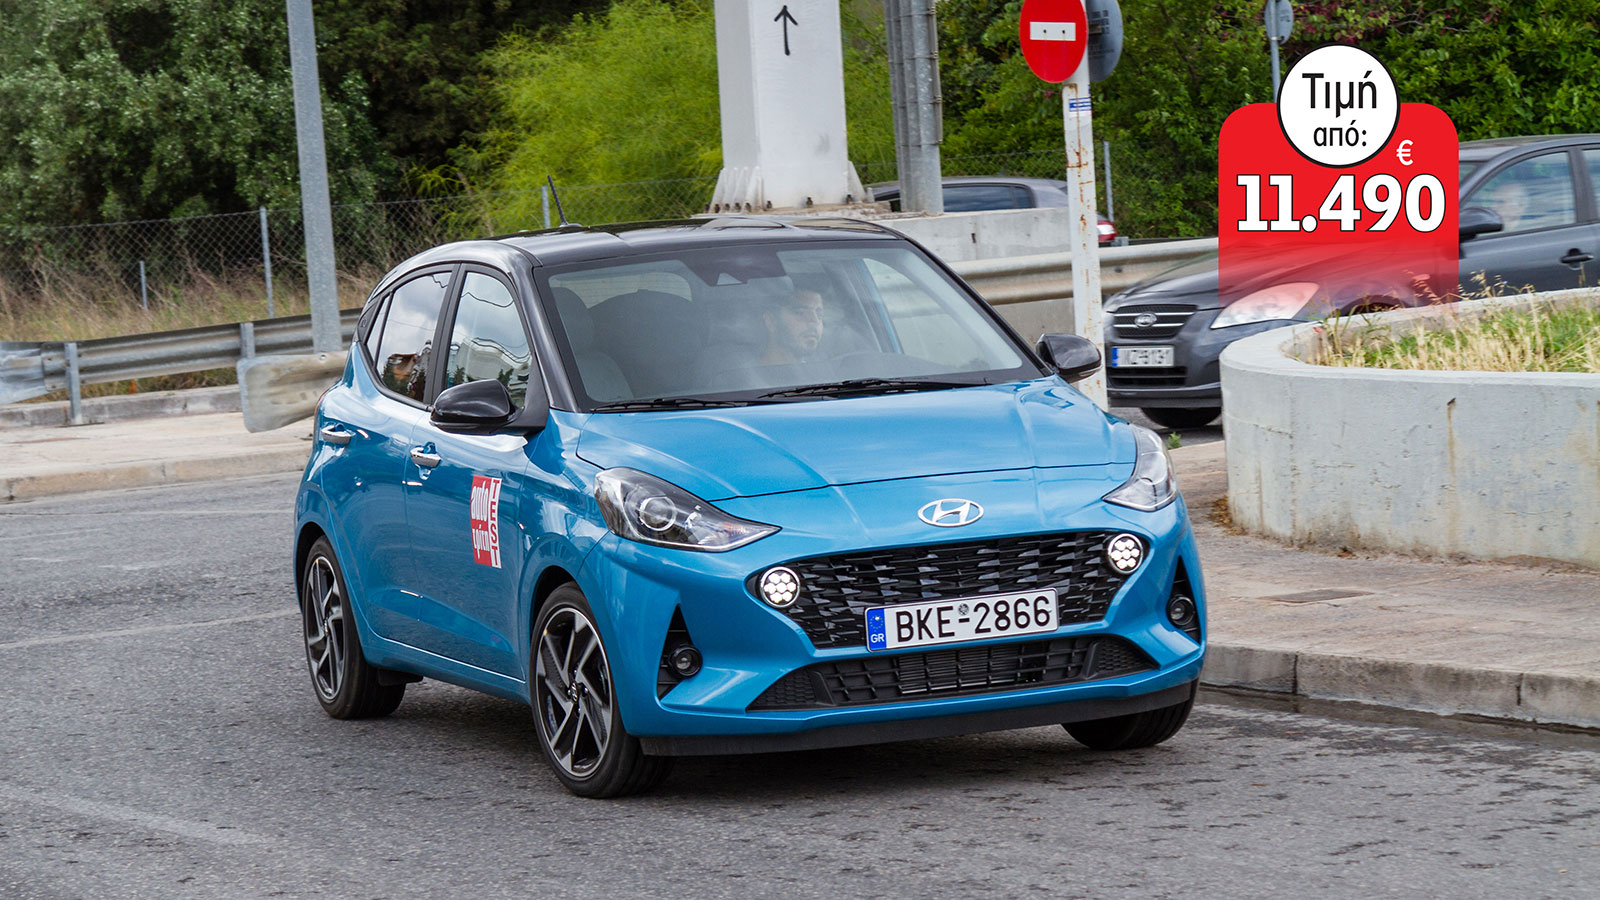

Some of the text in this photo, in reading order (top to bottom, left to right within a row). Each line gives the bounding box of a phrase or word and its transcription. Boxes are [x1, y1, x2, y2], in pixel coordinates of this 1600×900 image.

[471, 480, 489, 522] auto
[490, 479, 500, 566] TEST
[870, 633, 885, 644] GR
[896, 595, 1051, 643] BKE-2866
